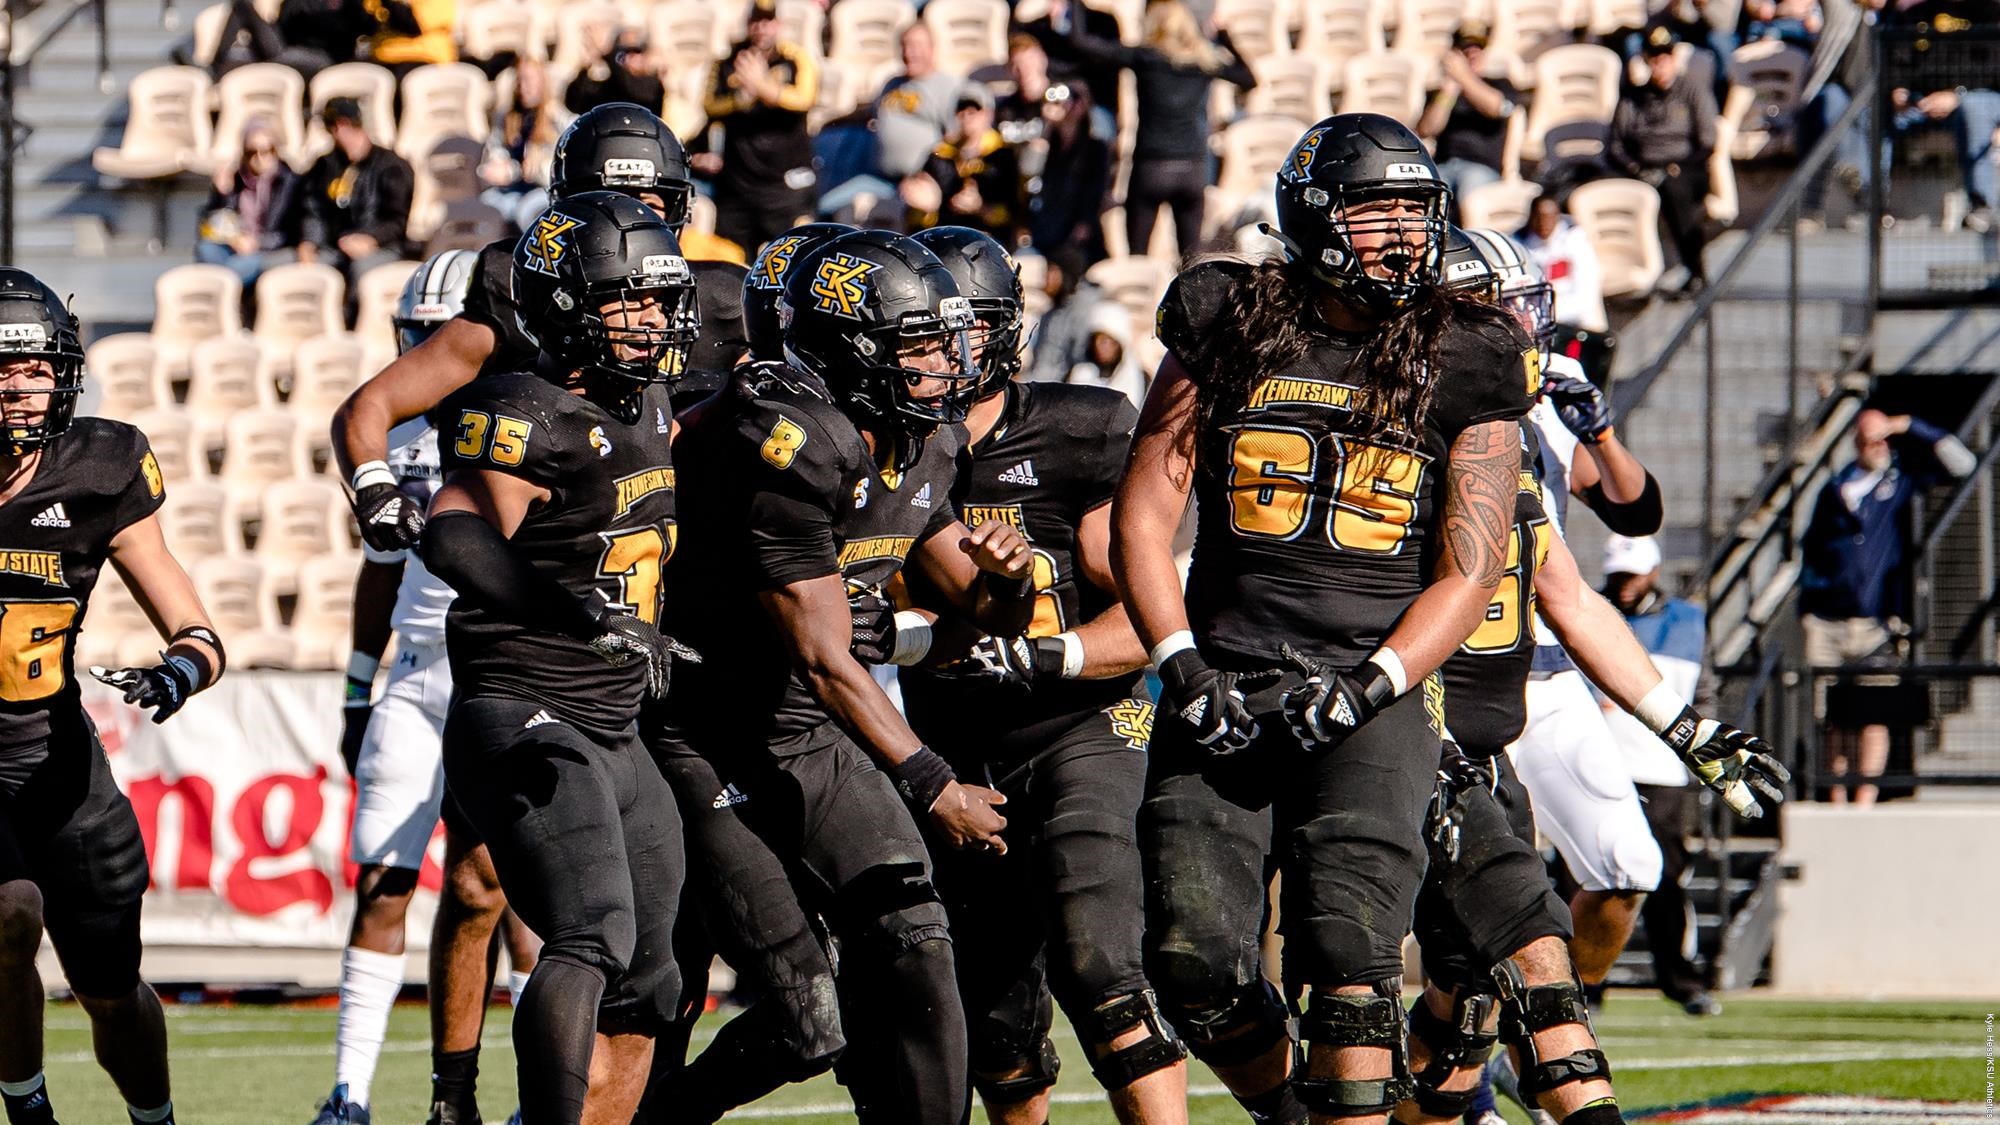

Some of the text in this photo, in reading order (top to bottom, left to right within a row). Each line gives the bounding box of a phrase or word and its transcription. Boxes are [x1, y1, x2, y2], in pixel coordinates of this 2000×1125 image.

[1399, 164, 1425, 174] E.A.T.
[3, 328, 34, 338] E.A.T.
[1247, 377, 1351, 410] KENNESAW
[455, 408, 532, 468] 35
[760, 413, 808, 470] 8
[997, 472, 1040, 487] adidas
[1218, 423, 1437, 557] 65
[30, 515, 71, 529] adidas
[9, 550, 64, 586] STATE
[712, 793, 749, 809] adidas
